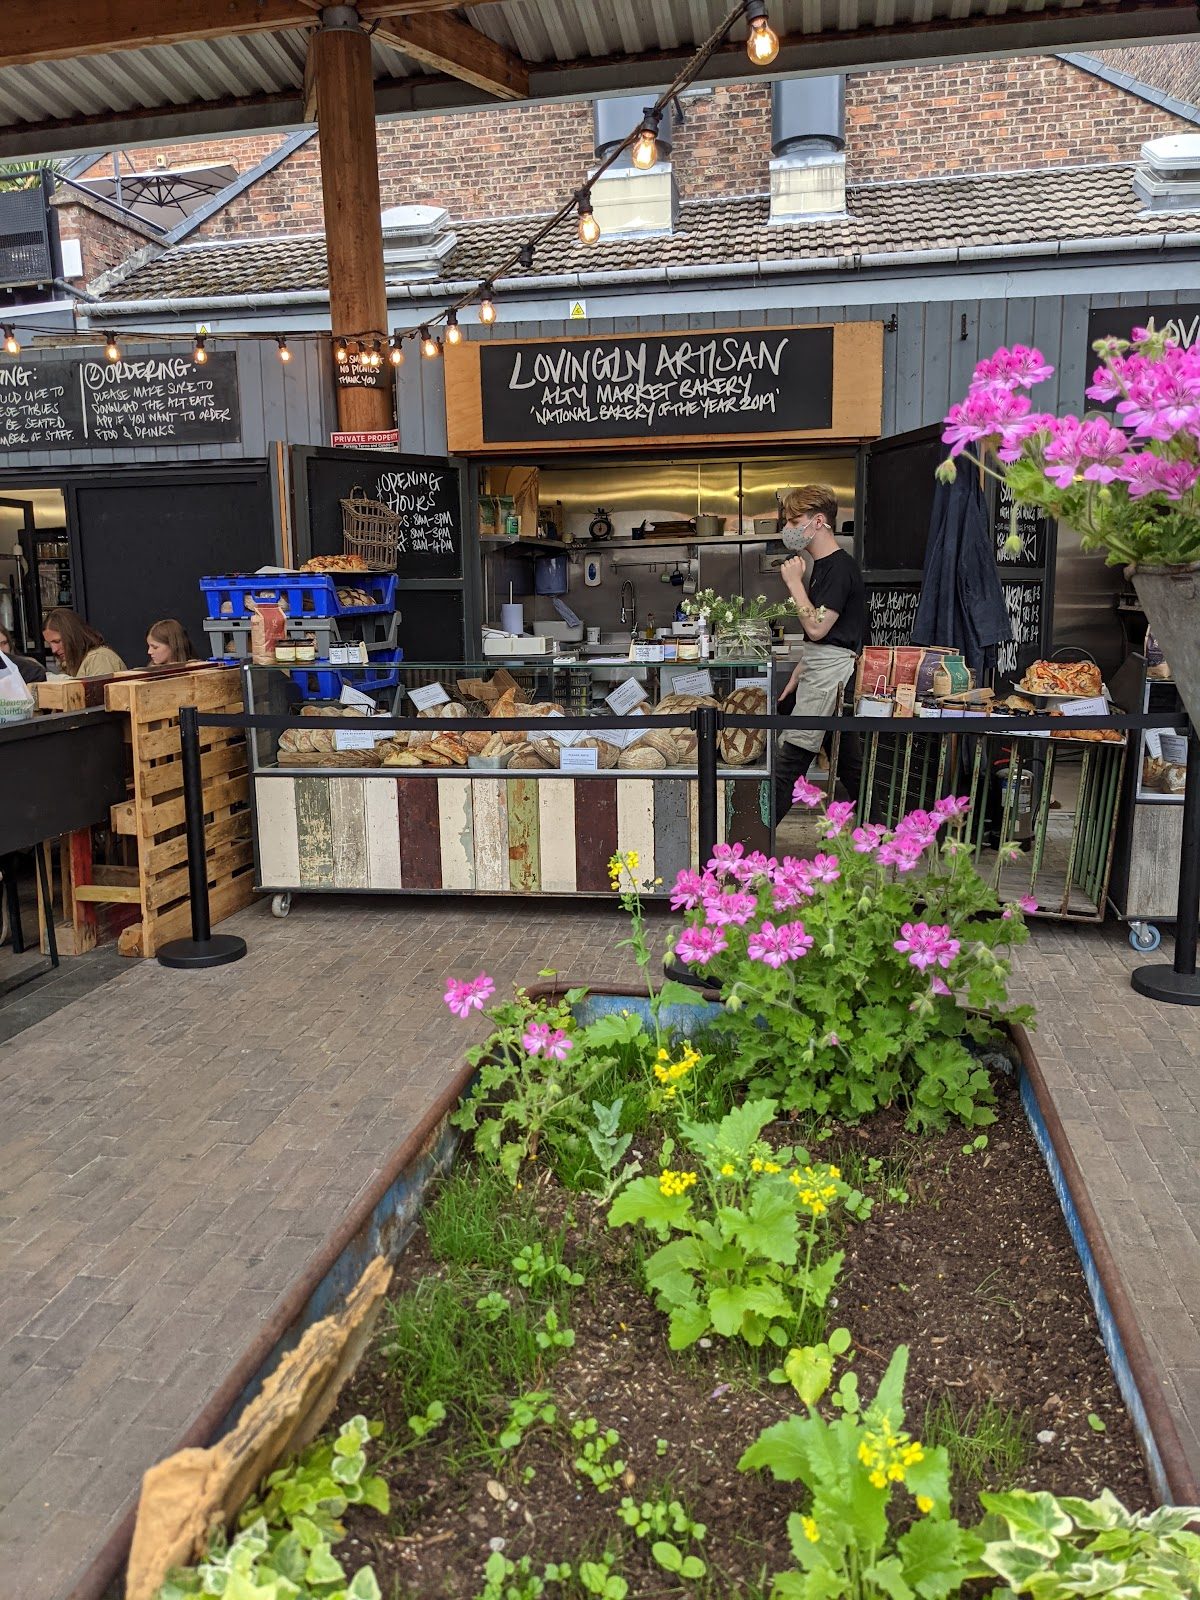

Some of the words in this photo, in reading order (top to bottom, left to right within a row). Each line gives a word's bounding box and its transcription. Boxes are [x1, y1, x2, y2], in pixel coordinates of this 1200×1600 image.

[509, 343, 646, 389] LOVINGLY
[655, 338, 789, 379] ARTISAN
[338, 375, 361, 384] THANK
[361, 375, 376, 386] YOU
[541, 383, 587, 408] ALTY
[597, 380, 678, 404] MARKET
[680, 372, 752, 401] BAKERY
[50, 386, 64, 398] TO
[93, 389, 130, 404] PLEASE
[133, 385, 166, 397] MAKE
[168, 381, 197, 394] SURE
[197, 380, 213, 390] TO
[19, 402, 59, 416] TABLES
[91, 401, 139, 415] DOWNLOAD
[142, 400, 166, 411] THE
[190, 395, 214, 407] EATS
[600, 402, 655, 426] BAKERY
[658, 401, 669, 416] OF
[668, 400, 701, 416] THE
[700, 396, 740, 419] YEAR
[6, 418, 21, 430] BE
[25, 415, 65, 429] SEATED
[96, 415, 113, 428] APP
[115, 415, 124, 424] IF
[130, 411, 146, 425] YOU
[148, 411, 179, 423] WANT
[180, 411, 195, 422] TO
[199, 408, 231, 422] ORDER
[31, 431, 42, 442] OF
[94, 429, 118, 441] FOOD
[123, 426, 133, 440] &
[135, 424, 176, 439] DRINKS
[381, 471, 443, 494] OPENING
[387, 491, 435, 514] HOURS
